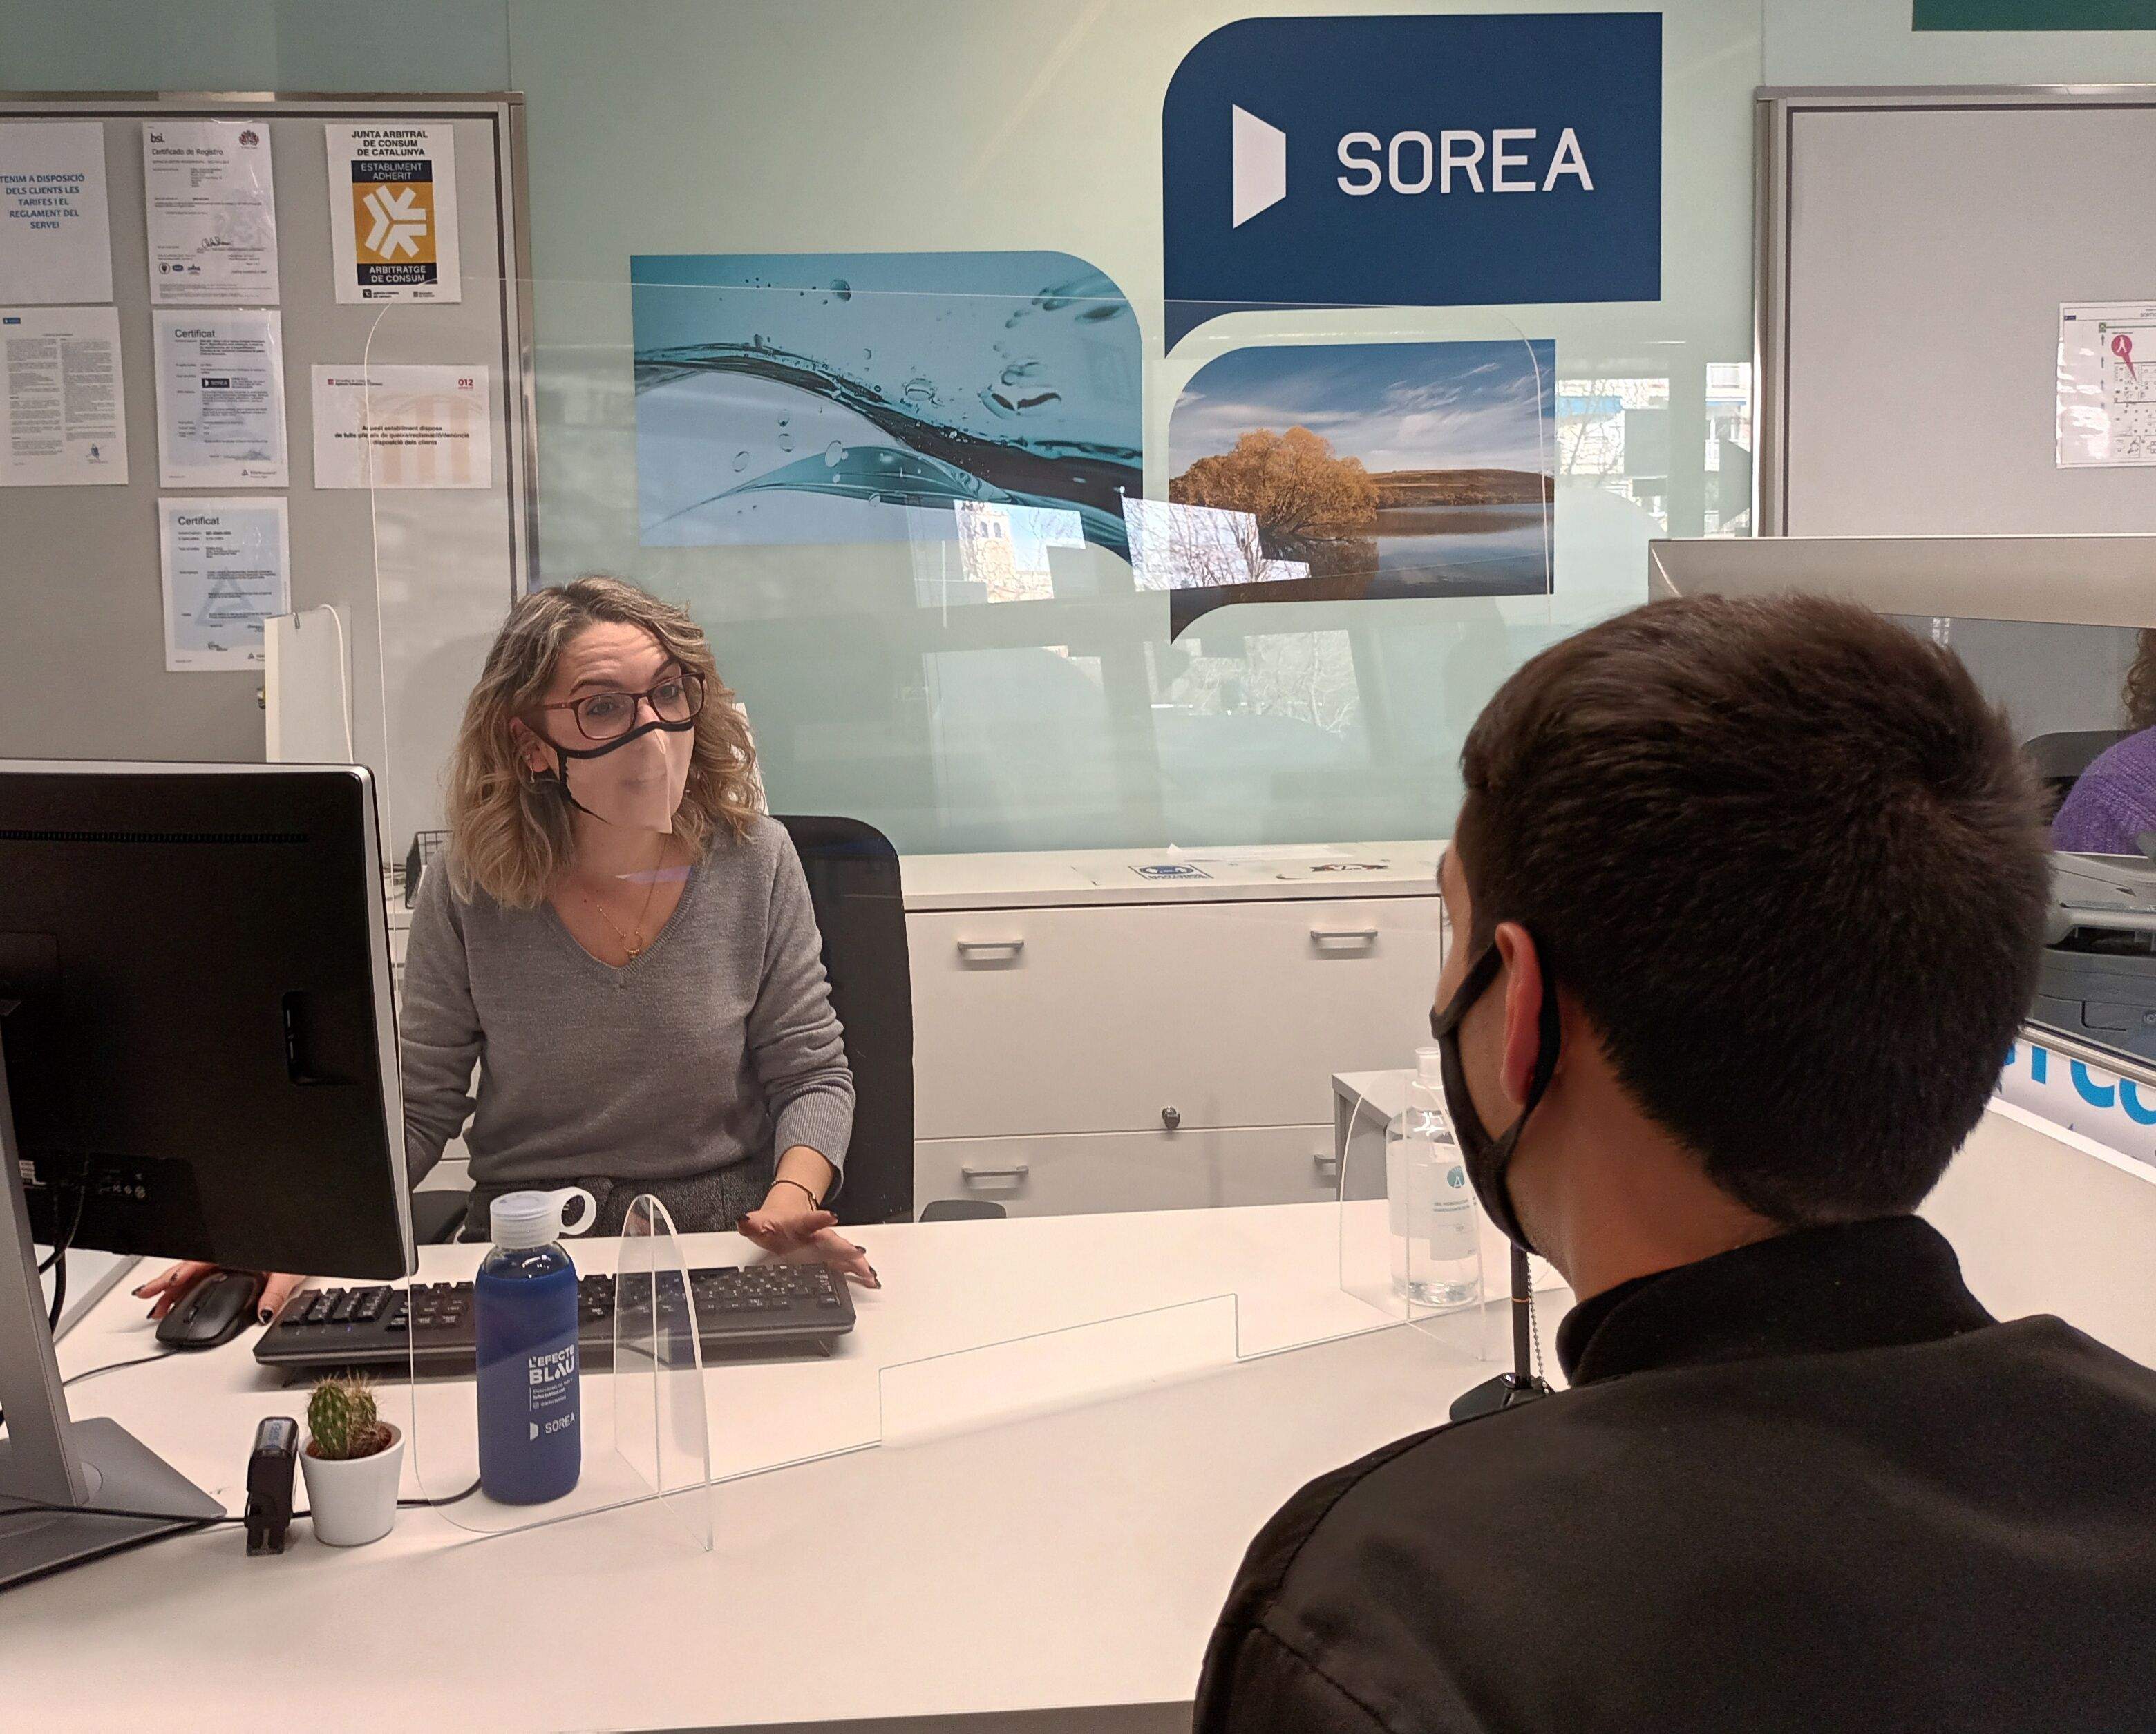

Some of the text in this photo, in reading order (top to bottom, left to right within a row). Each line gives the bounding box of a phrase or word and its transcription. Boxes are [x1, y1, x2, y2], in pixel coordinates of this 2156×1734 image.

[196, 149, 223, 157] Registro
[372, 148, 425, 156] CATALUNYA
[1337, 128, 1594, 196] SOREA
[361, 163, 422, 171] ESTABLIMENT
[37, 173, 84, 182] DISPOSICIÓ
[9, 209, 61, 218] REGLAMENT
[370, 265, 426, 274] ARBITRATGE
[386, 274, 425, 283] CONSUM
[175, 329, 215, 338] Certificat
[178, 516, 220, 525] Certificat
[529, 1355, 575, 1385] BLAU
[545, 1411, 575, 1434] SOREA
